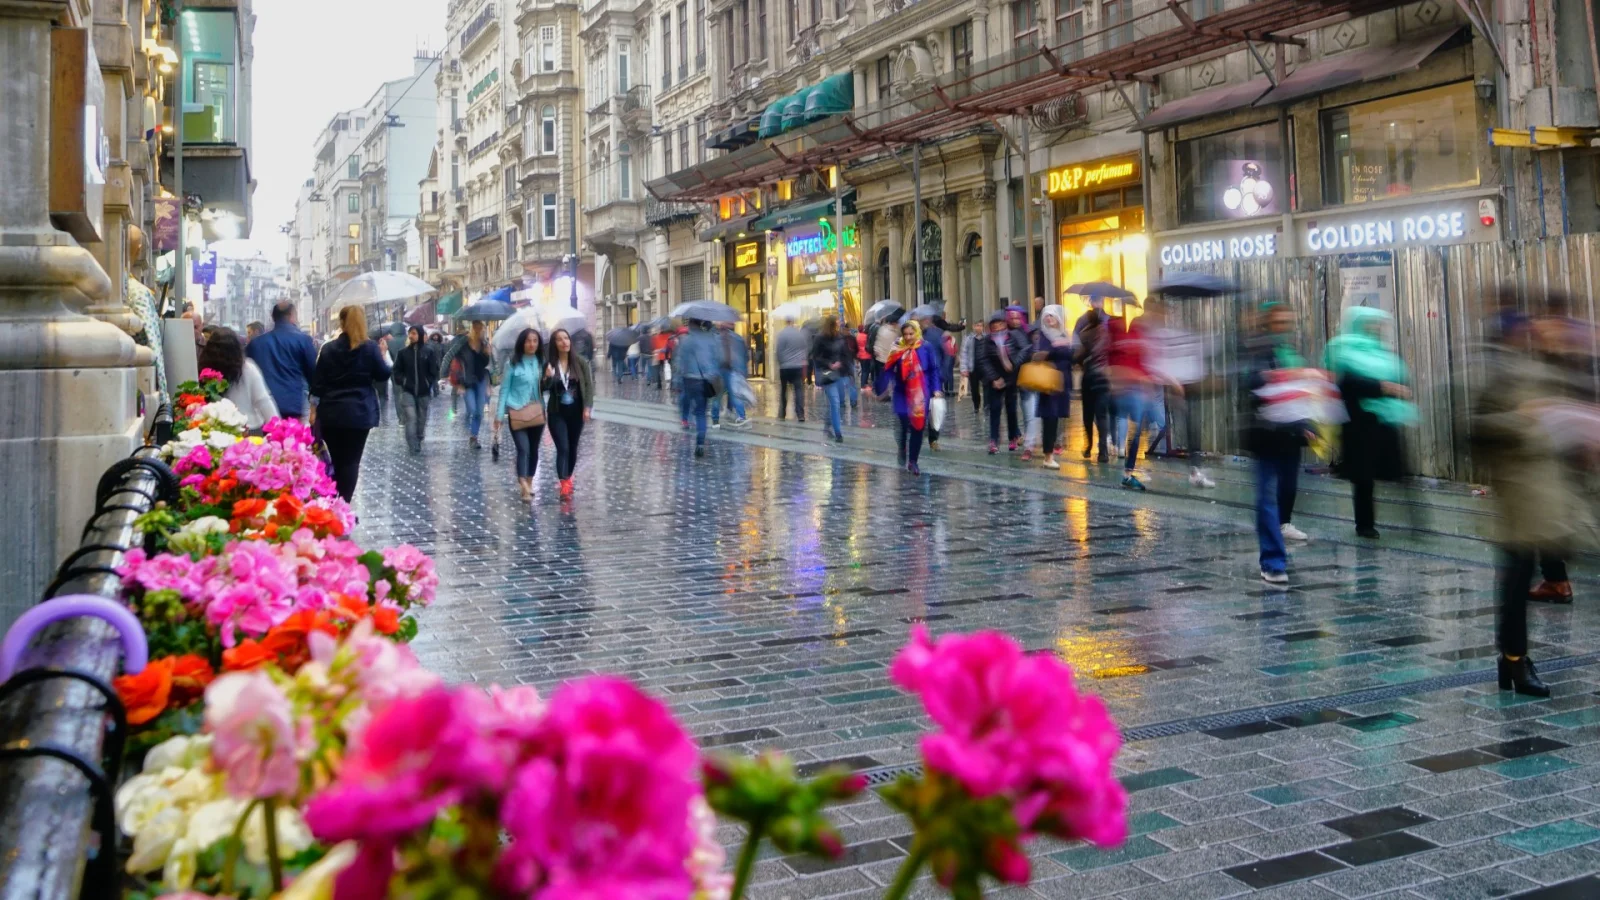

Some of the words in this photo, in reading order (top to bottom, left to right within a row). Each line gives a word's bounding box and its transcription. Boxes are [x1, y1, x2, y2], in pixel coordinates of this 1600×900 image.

[1049, 167, 1083, 193] D&P
[1084, 163, 1133, 187] perfumum
[1307, 219, 1395, 251] GOLDEN
[1402, 211, 1465, 241] ROSE
[1160, 239, 1225, 266] GOLDEN
[1229, 233, 1276, 259] ROSE
